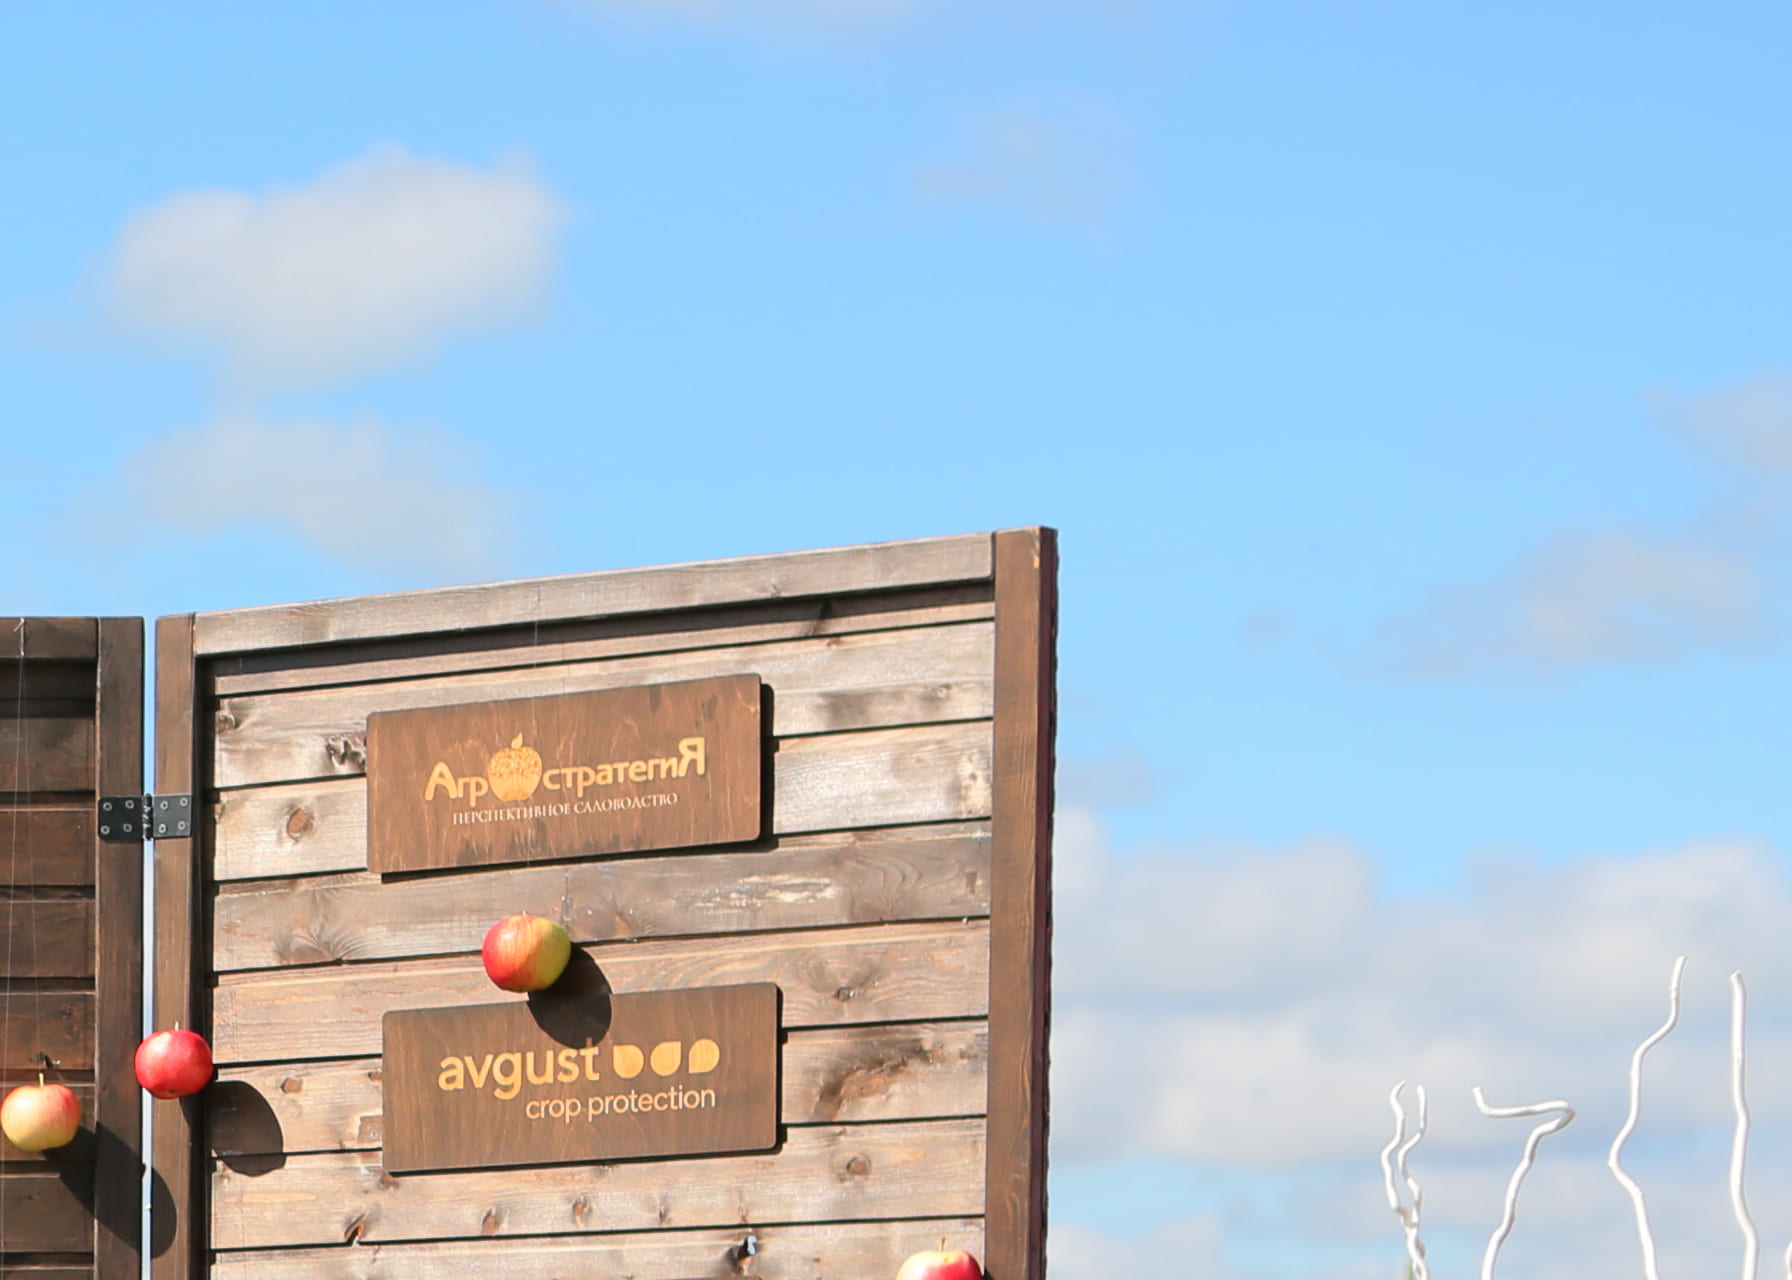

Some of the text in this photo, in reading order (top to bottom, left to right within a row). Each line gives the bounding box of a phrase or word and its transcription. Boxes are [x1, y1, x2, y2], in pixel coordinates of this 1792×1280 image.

[453, 792, 678, 825] ПЕРСПЕКТИВНОЕ САДОВОДСТВО
[438, 1037, 600, 1100] avgust
[526, 1085, 715, 1123] crop protection
